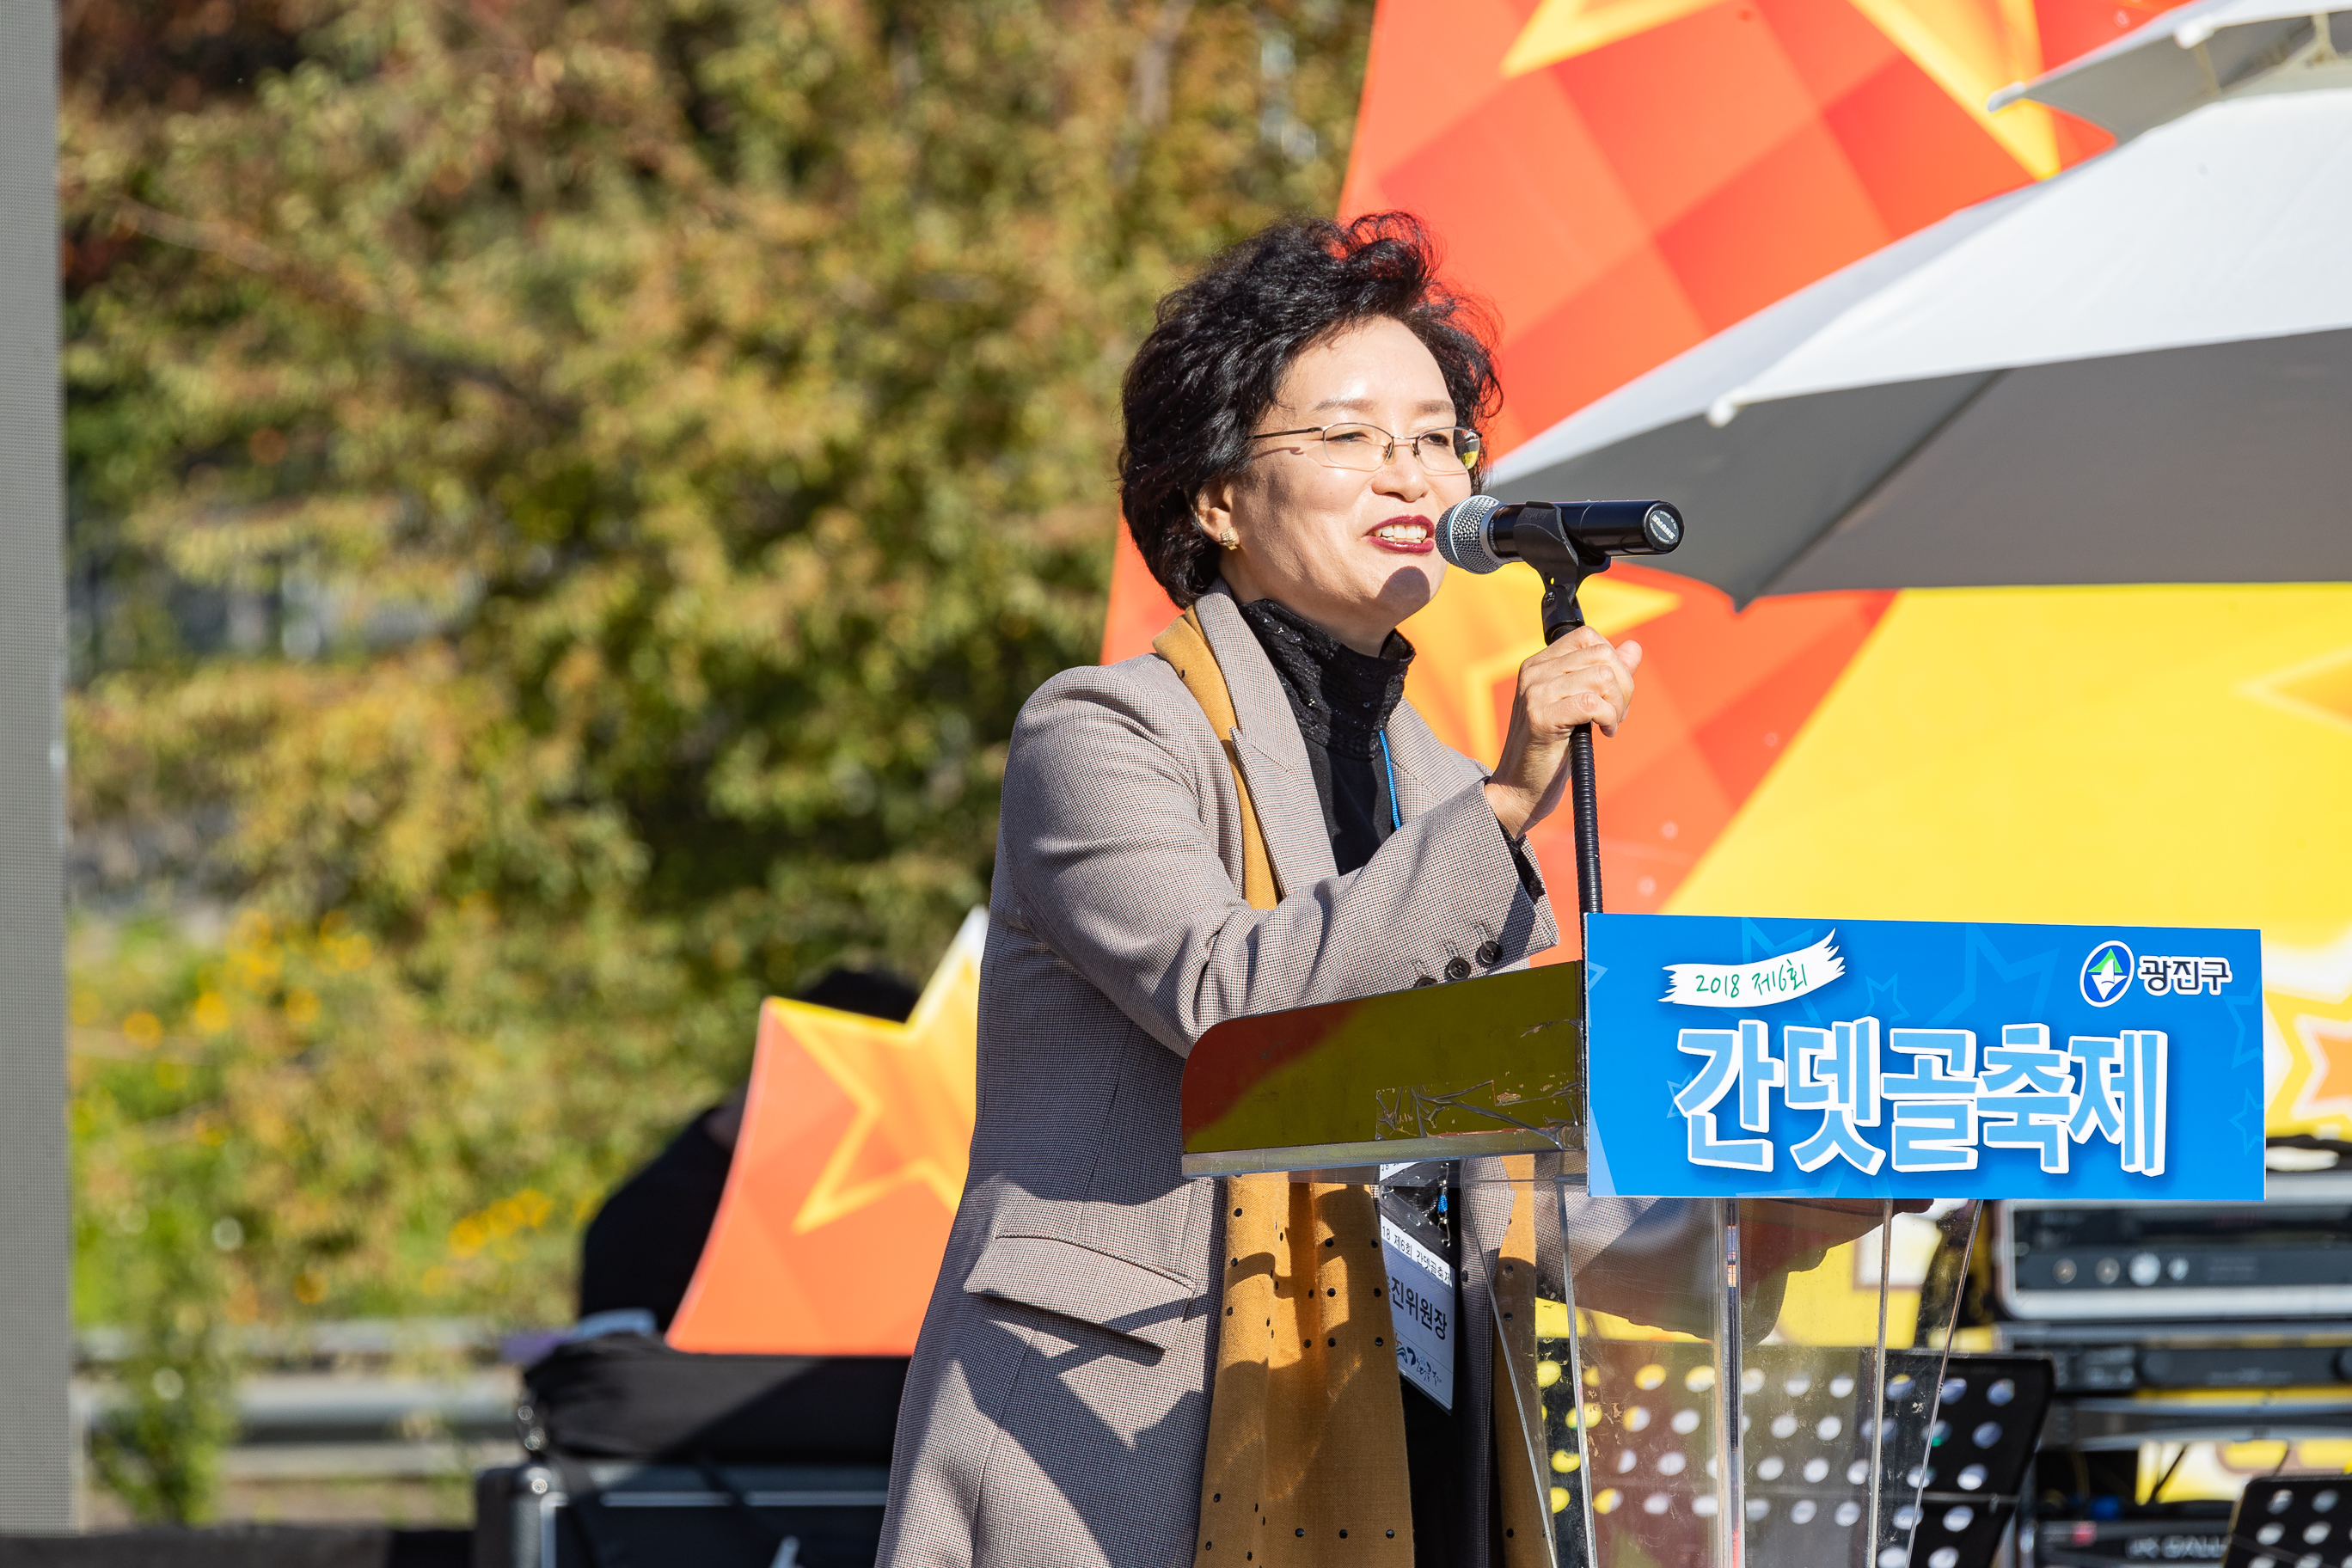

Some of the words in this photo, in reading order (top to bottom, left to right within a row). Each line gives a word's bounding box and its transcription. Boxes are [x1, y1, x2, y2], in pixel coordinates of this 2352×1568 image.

[1651, 514, 1676, 540] SHURE
[1695, 973, 1740, 998] 2018
[1752, 959, 1808, 995] 제6회
[2141, 959, 2230, 992] 광진구
[1674, 1015, 2169, 1178] 간뎃골축제
[1393, 1234, 1412, 1259] 제6회
[1387, 1276, 1448, 1341] 진위원장
